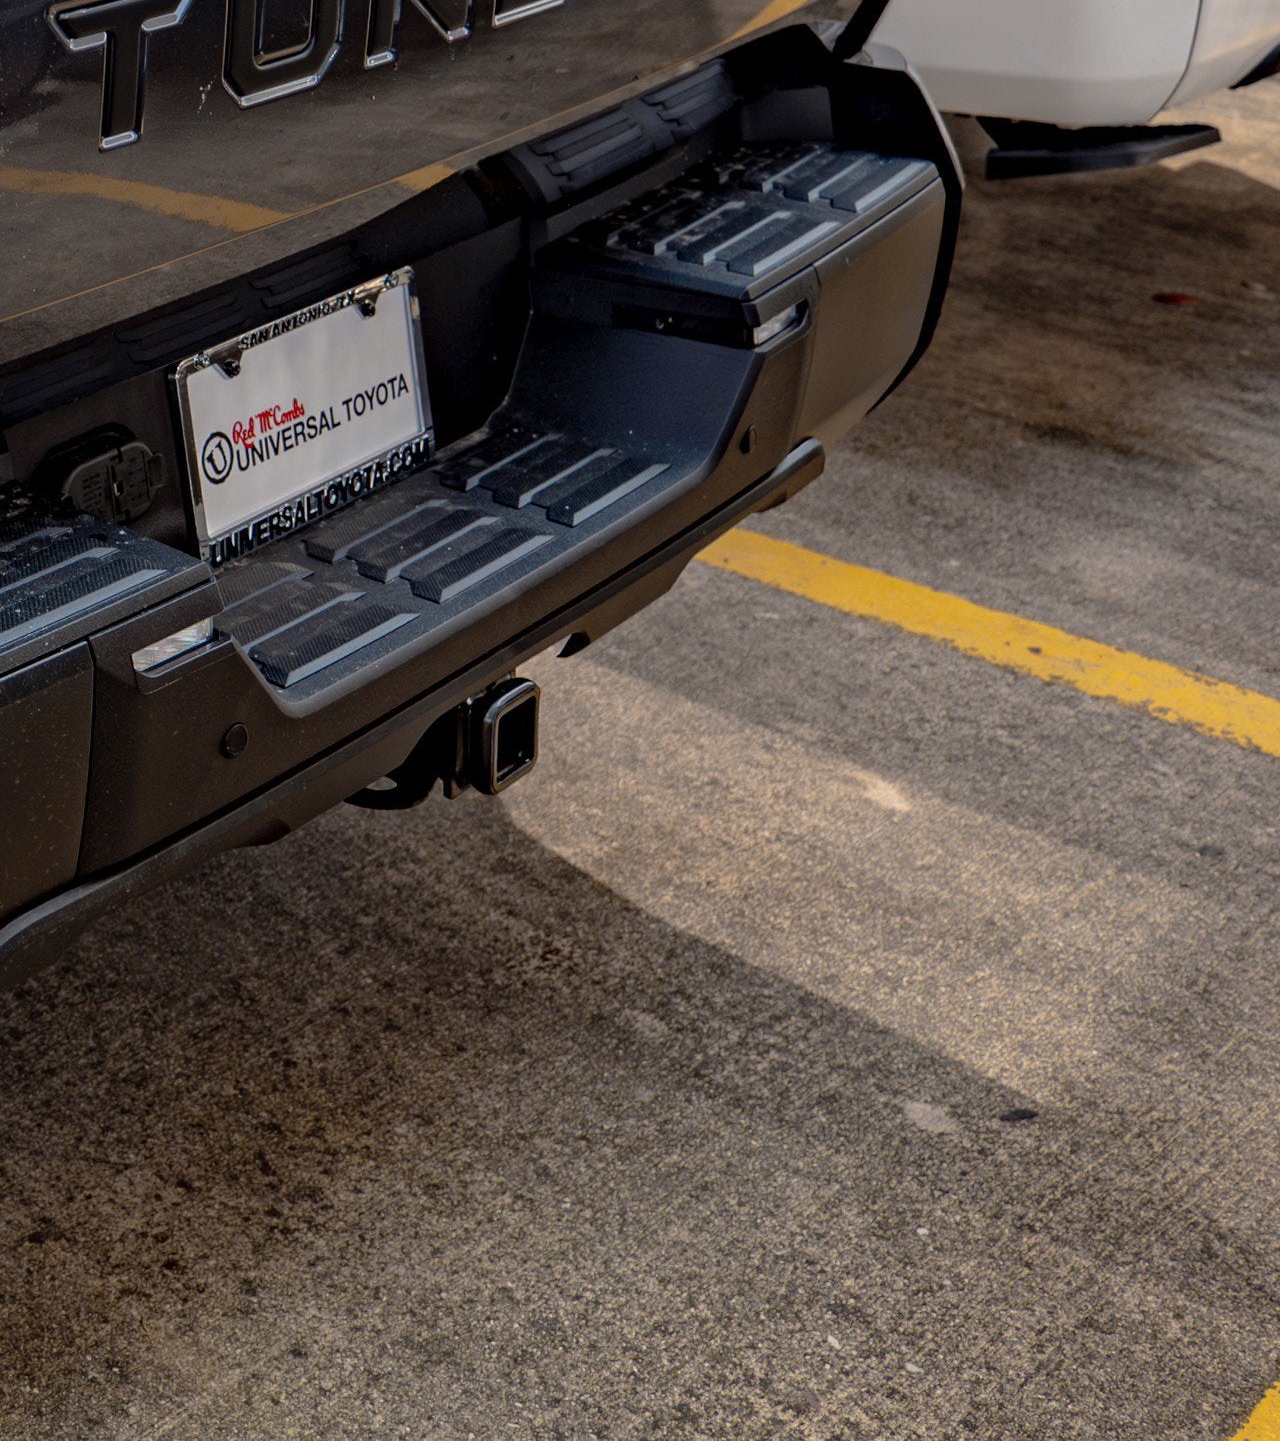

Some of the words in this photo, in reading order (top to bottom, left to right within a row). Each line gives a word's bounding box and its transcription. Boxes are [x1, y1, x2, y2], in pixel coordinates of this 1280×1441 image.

[240, 329, 269, 351] SAN
[232, 417, 255, 448] Red
[255, 397, 305, 433] McCombs
[236, 406, 341, 472] UNIVERSAL
[342, 373, 409, 422] TOYOTA
[208, 434, 431, 568] UNIVERSALTOYOTA.COM
